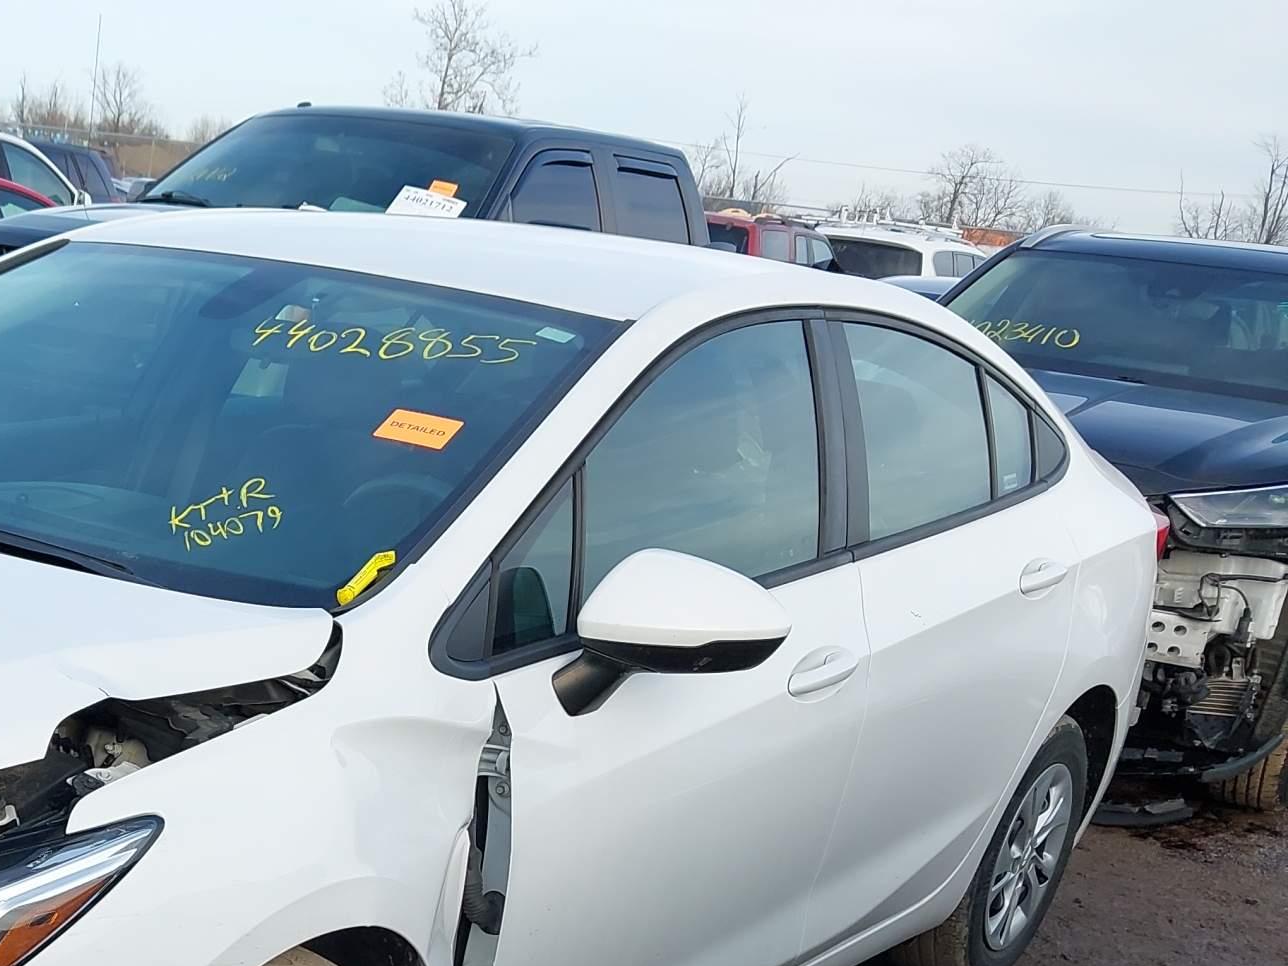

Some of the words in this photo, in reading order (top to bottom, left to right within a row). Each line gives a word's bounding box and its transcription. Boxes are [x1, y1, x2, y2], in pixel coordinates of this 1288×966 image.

[252, 319, 537, 364] 44028855
[389, 420, 446, 437] DETAILED
[184, 506, 283, 552] 104079
